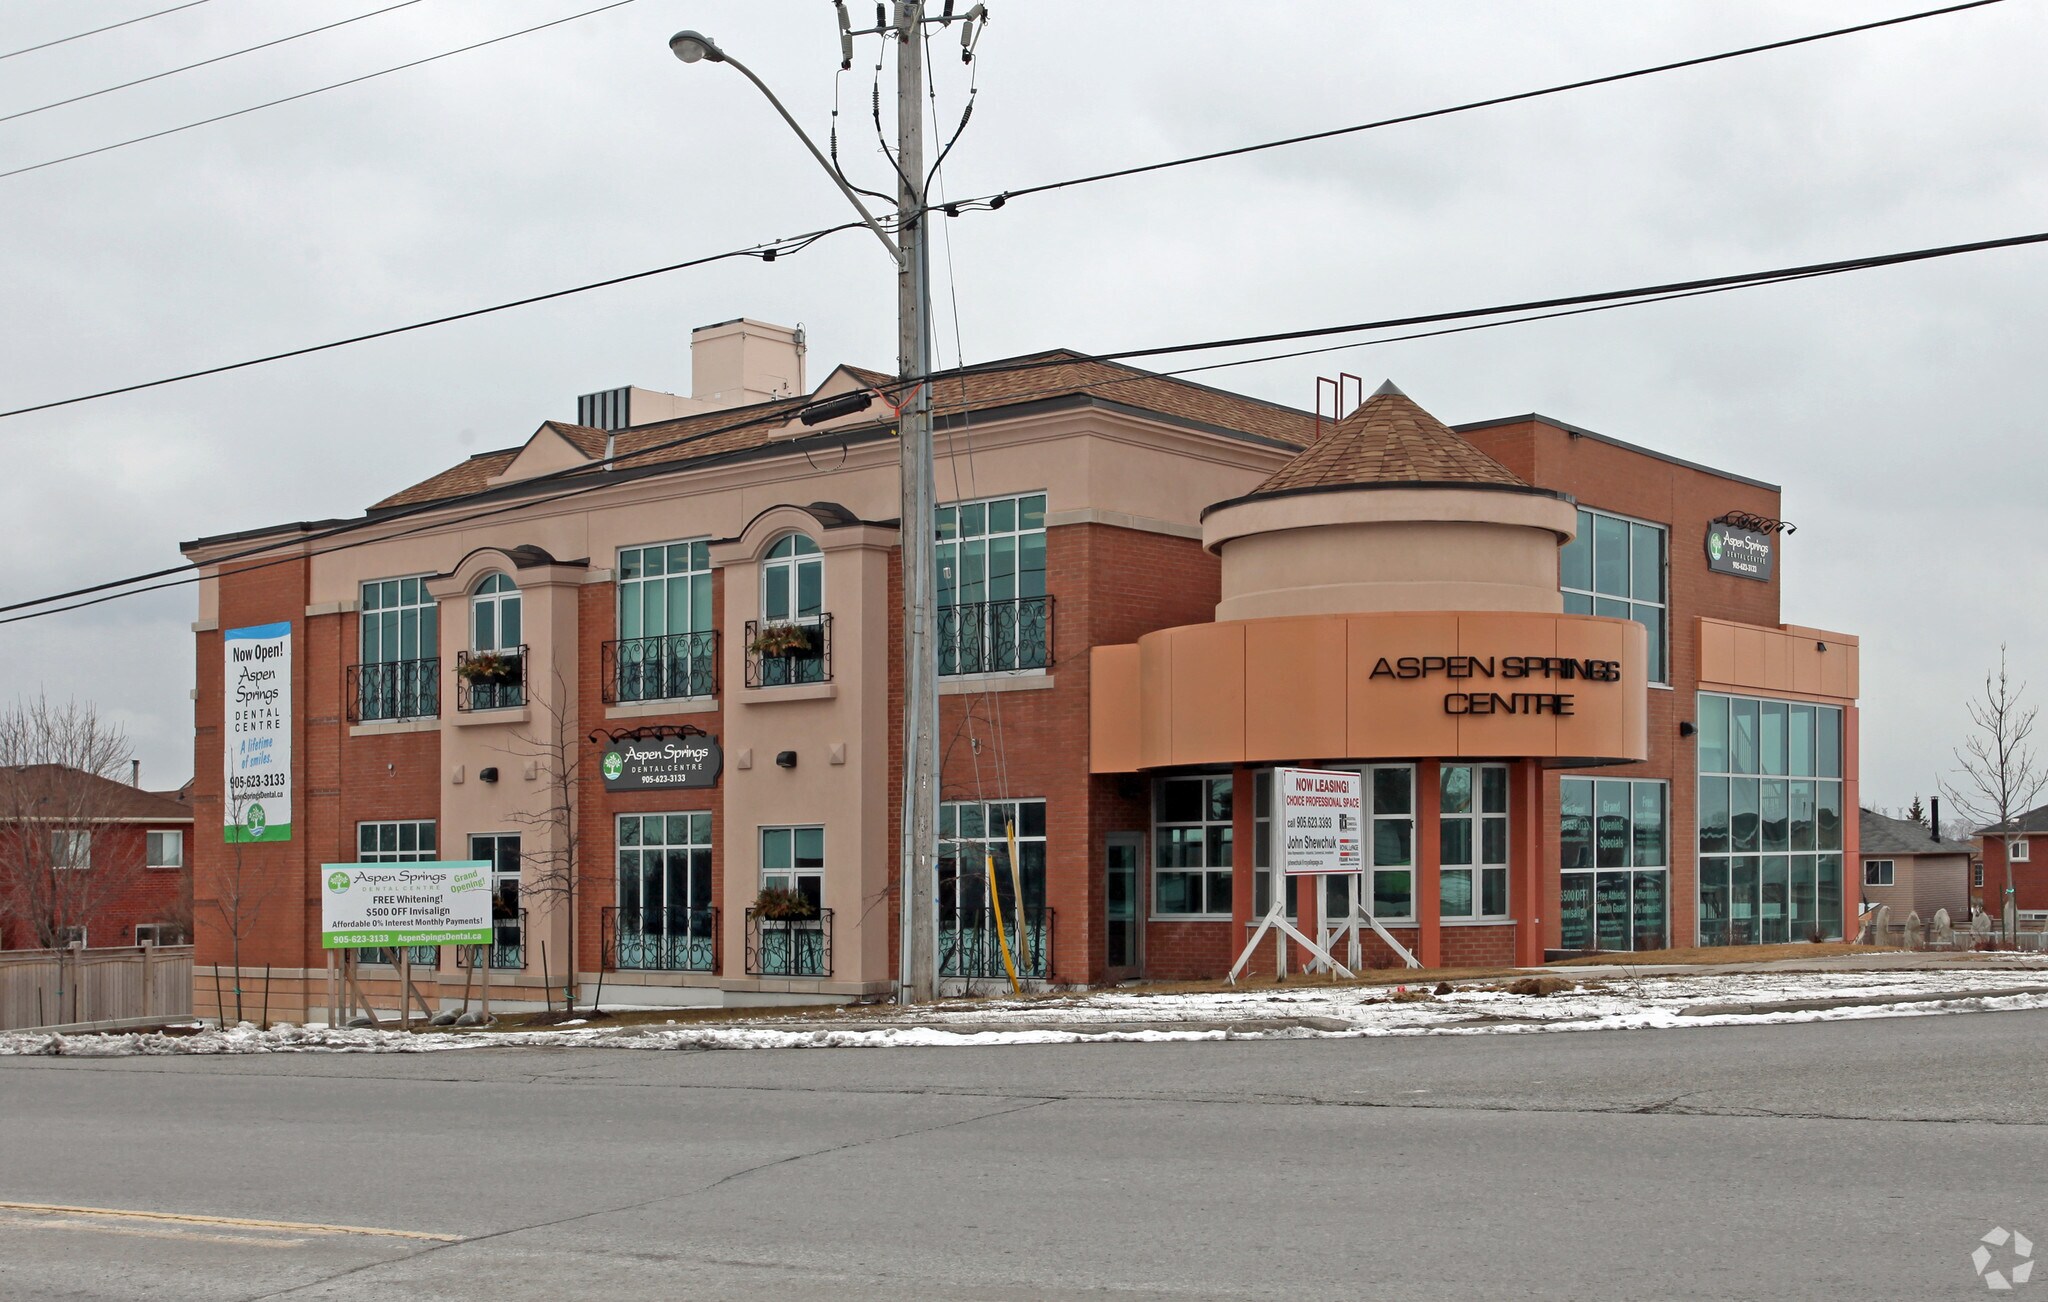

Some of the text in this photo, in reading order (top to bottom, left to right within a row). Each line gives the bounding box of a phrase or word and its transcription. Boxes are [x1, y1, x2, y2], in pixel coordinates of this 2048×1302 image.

[1723, 531, 1769, 557] Aspen Springs
[233, 641, 283, 663] Now Open!
[238, 666, 276, 686] Aspen
[1369, 656, 1621, 682] ASPEN SPRINGS
[235, 685, 279, 707] Springs
[1444, 692, 1575, 716] CENTRE
[235, 708, 280, 721] DENTAL
[235, 719, 280, 733] CENTRE
[240, 737, 273, 755] A lifetime
[241, 752, 273, 769] of smiles.
[624, 744, 709, 765] Aspen Springs
[631, 763, 703, 773] DENTAL CENTRE
[230, 773, 285, 789] 905-623-3133
[641, 774, 686, 784] 905-623-3133
[1296, 778, 1349, 793] NOW LEASING!
[1286, 795, 1360, 809] CHOICE PROFESSIONAL SPACE
[1603, 800, 1621, 813] Grand
[1287, 818, 1295, 828] call
[1600, 818, 1624, 833] Opening
[1287, 835, 1337, 849] John Shewchuk
[1600, 836, 1624, 850] Specials
[353, 870, 447, 887] Aspen Springs
[453, 870, 478, 883] Grand
[450, 877, 486, 894] Opening!
[373, 894, 443, 905] FREE Whitening!
[366, 906, 450, 917] $500 OFF Invisalign
[332, 917, 483, 928] Affordable 0% Interest Monthly Payments!
[333, 932, 482, 944] 905-623-3133 AspenSpingsDental.ca
